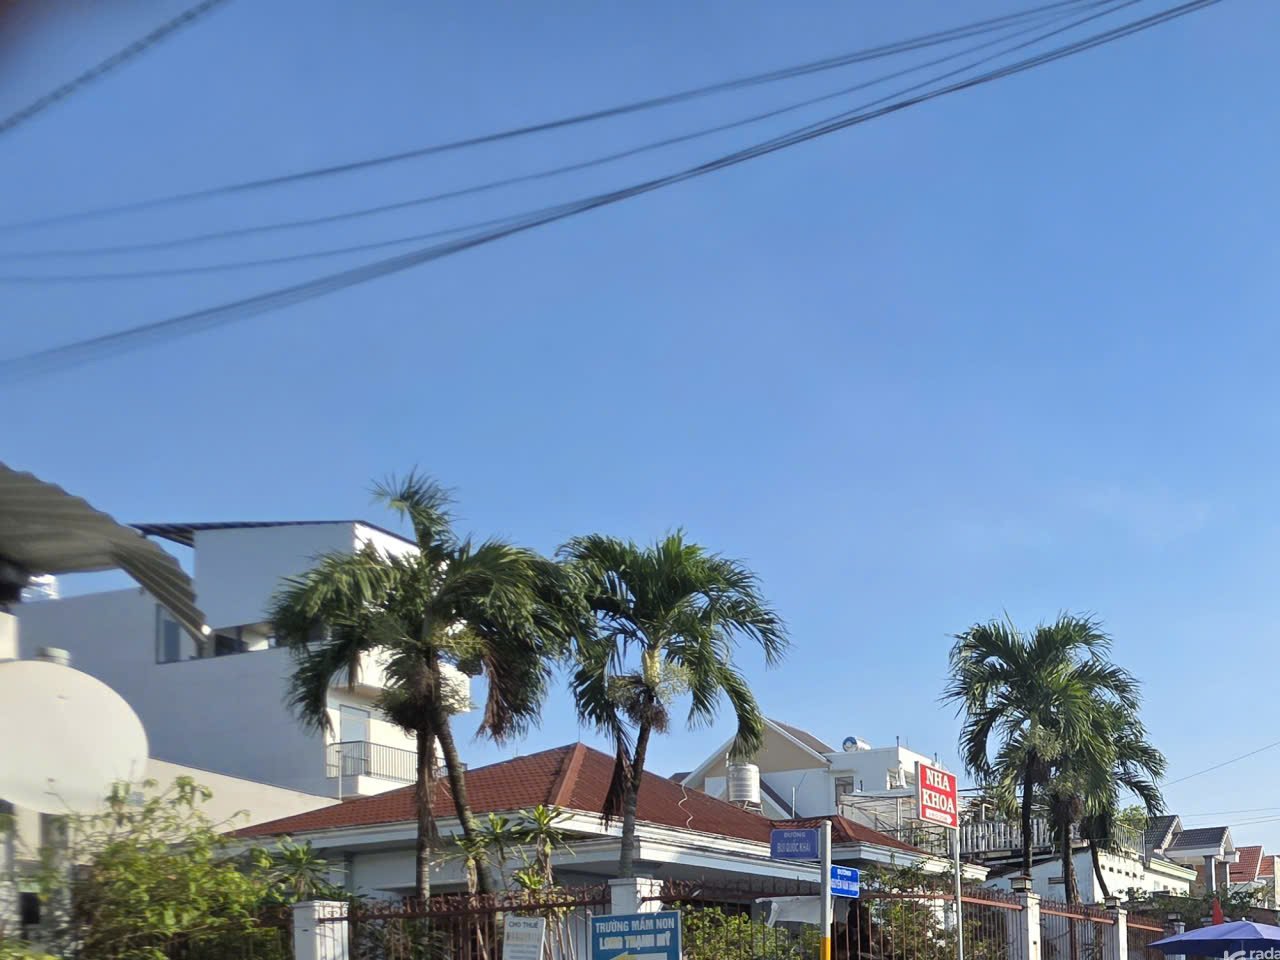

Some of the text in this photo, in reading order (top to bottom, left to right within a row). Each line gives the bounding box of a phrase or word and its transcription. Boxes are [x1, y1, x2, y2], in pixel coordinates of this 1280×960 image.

[925, 768, 951, 792] NHA
[922, 788, 956, 814] KHOA
[595, 919, 630, 933] TRƯỜNG
[656, 917, 675, 929] NON
